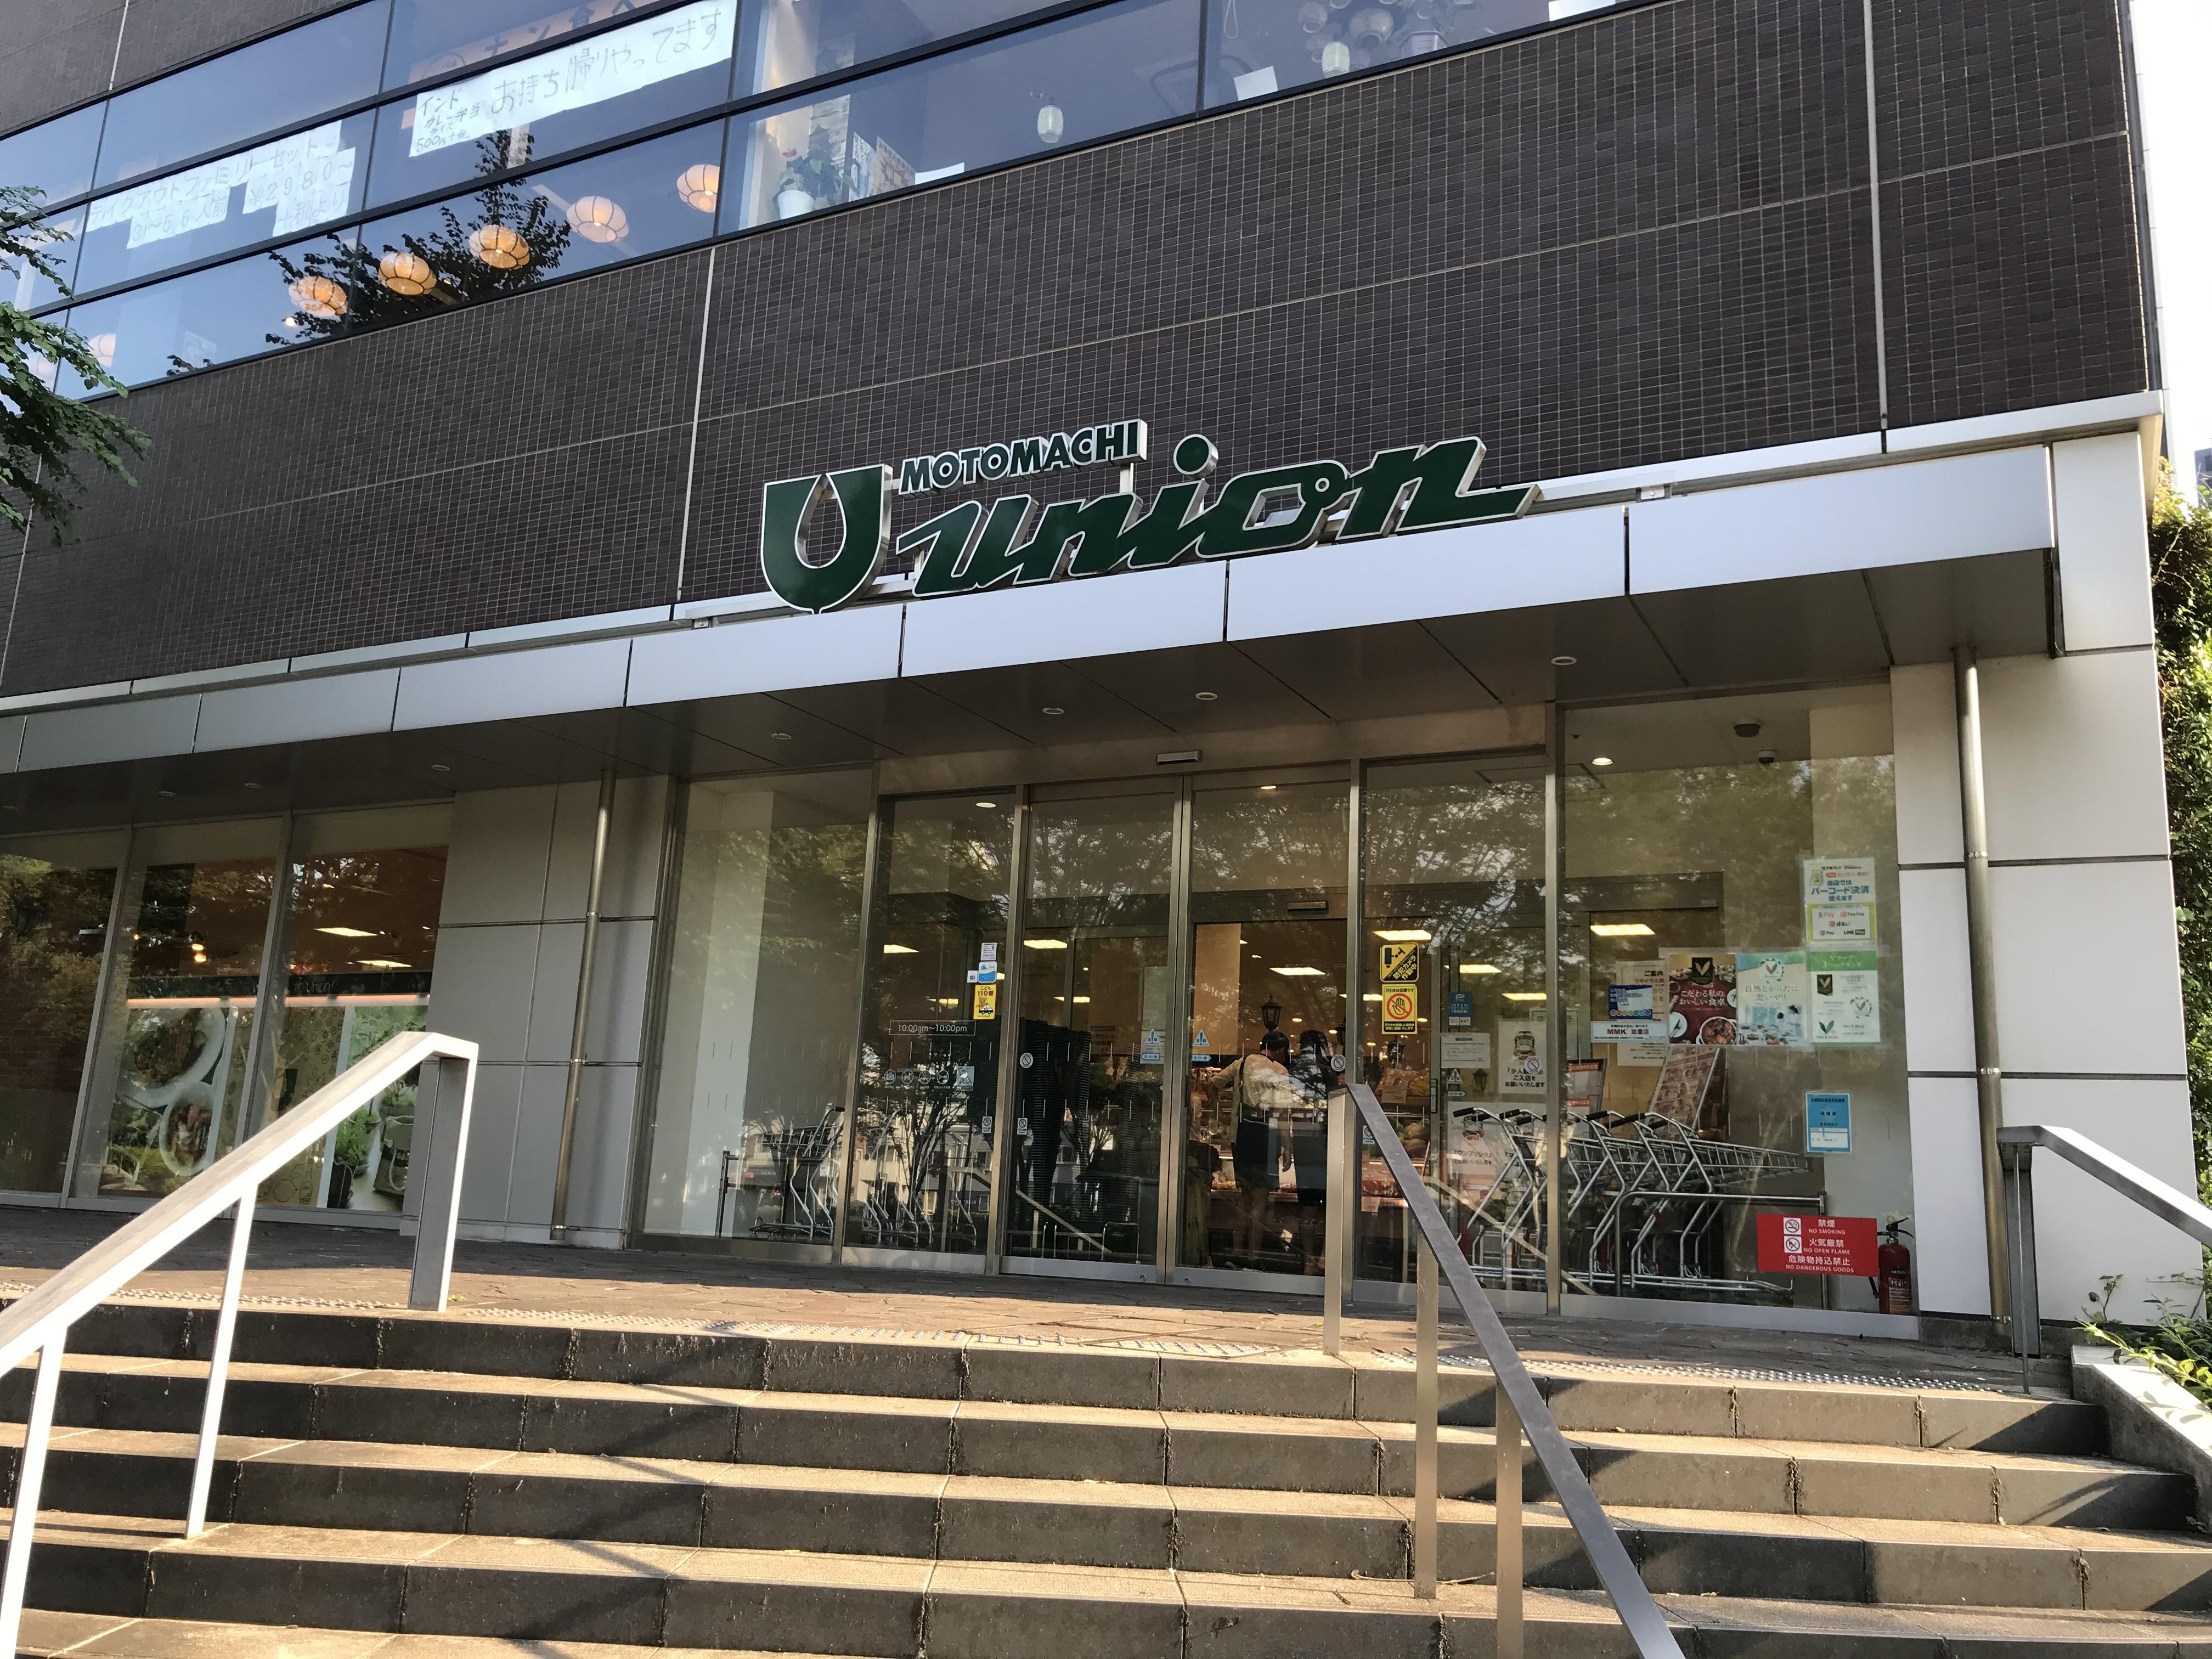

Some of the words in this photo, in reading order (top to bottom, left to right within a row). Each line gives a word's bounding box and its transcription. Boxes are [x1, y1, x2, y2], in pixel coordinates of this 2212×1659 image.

[491, 8, 722, 114] お持ち帰りやってます
[418, 88, 462, 117] インド
[424, 101, 480, 128] カレー弁当
[898, 419, 1148, 498] MOTOMACHI
[895, 434, 1541, 597] union
[1811, 885, 1870, 895] バーコード決済
[1392, 955, 1417, 980] 防犯カメラ
[1401, 963, 1418, 980] 作動中
[1745, 985, 1800, 993] 自然とからだに
[1818, 1219, 1835, 1228] 禁煙
[1809, 1238, 1844, 1248] 火気厳禁
[1788, 1255, 1850, 1266] 危険物持込禁止
